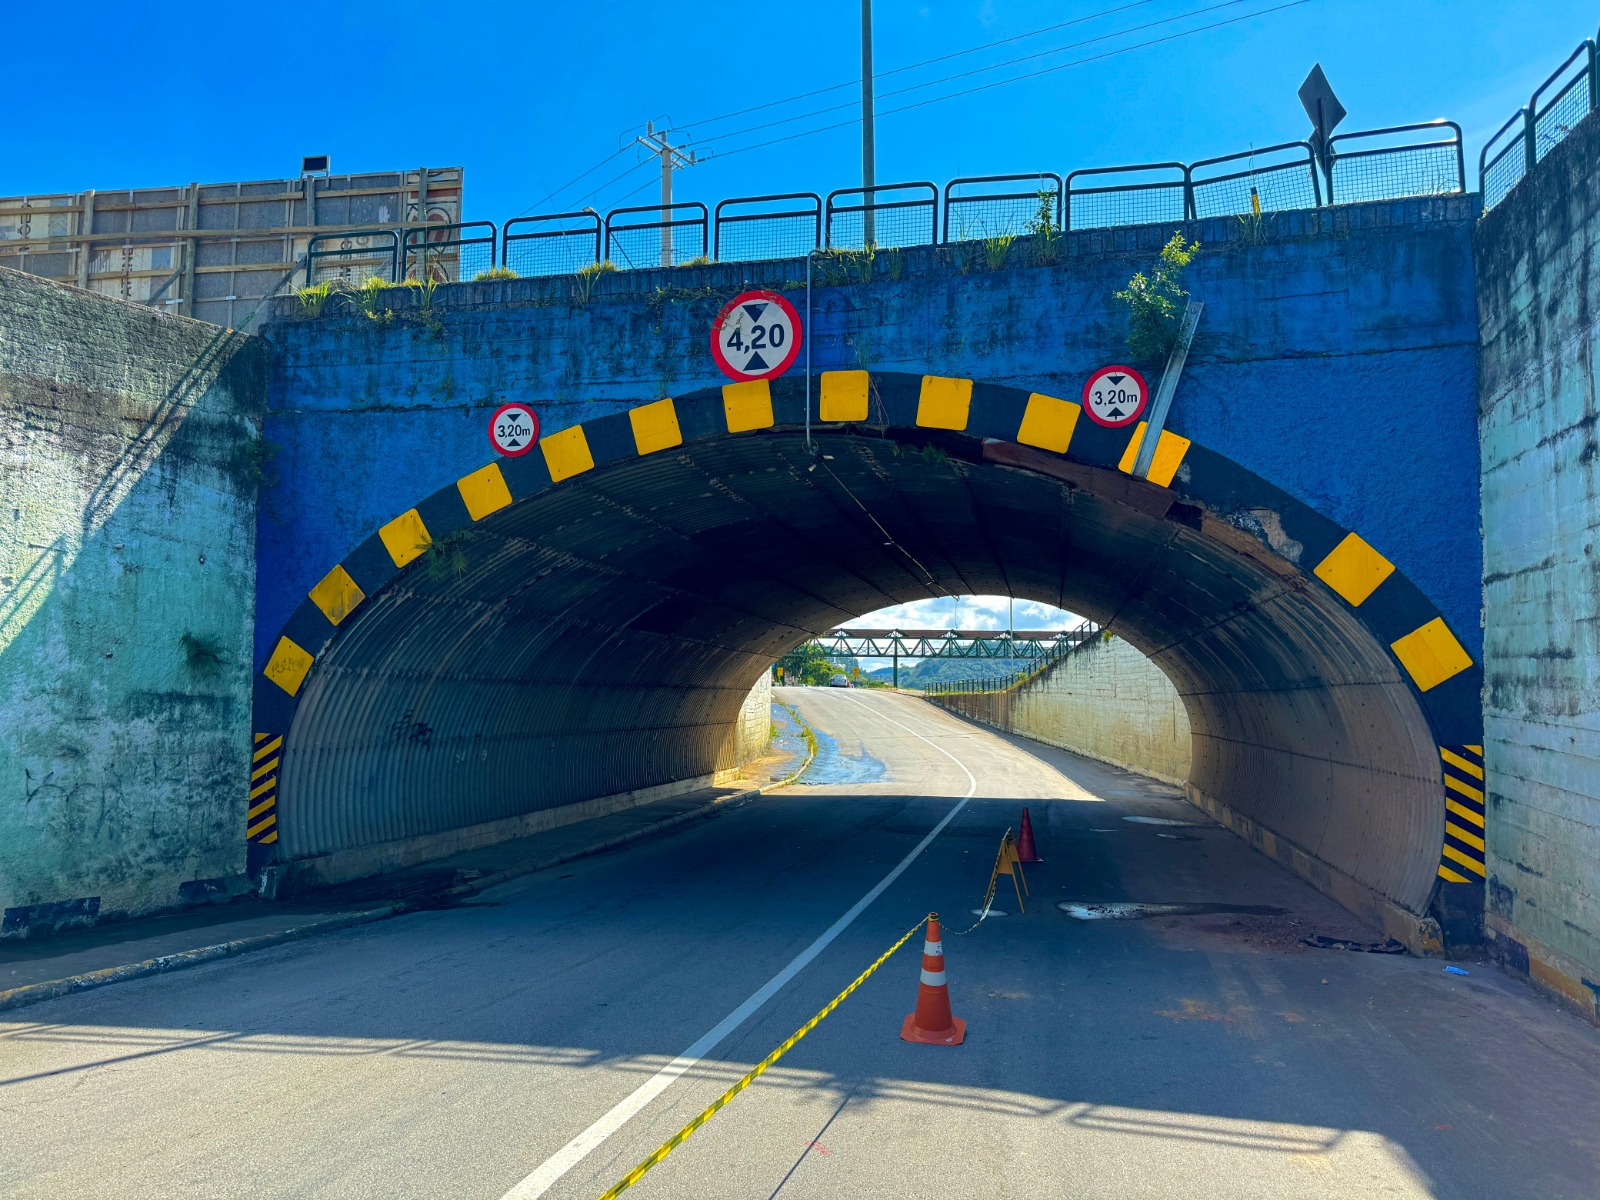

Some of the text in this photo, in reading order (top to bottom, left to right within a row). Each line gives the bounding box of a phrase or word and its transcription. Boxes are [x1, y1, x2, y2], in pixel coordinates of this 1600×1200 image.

[726, 323, 785, 354] 4,20
[1094, 389, 1138, 407] 3,20m
[497, 424, 531, 439] 3,20m
